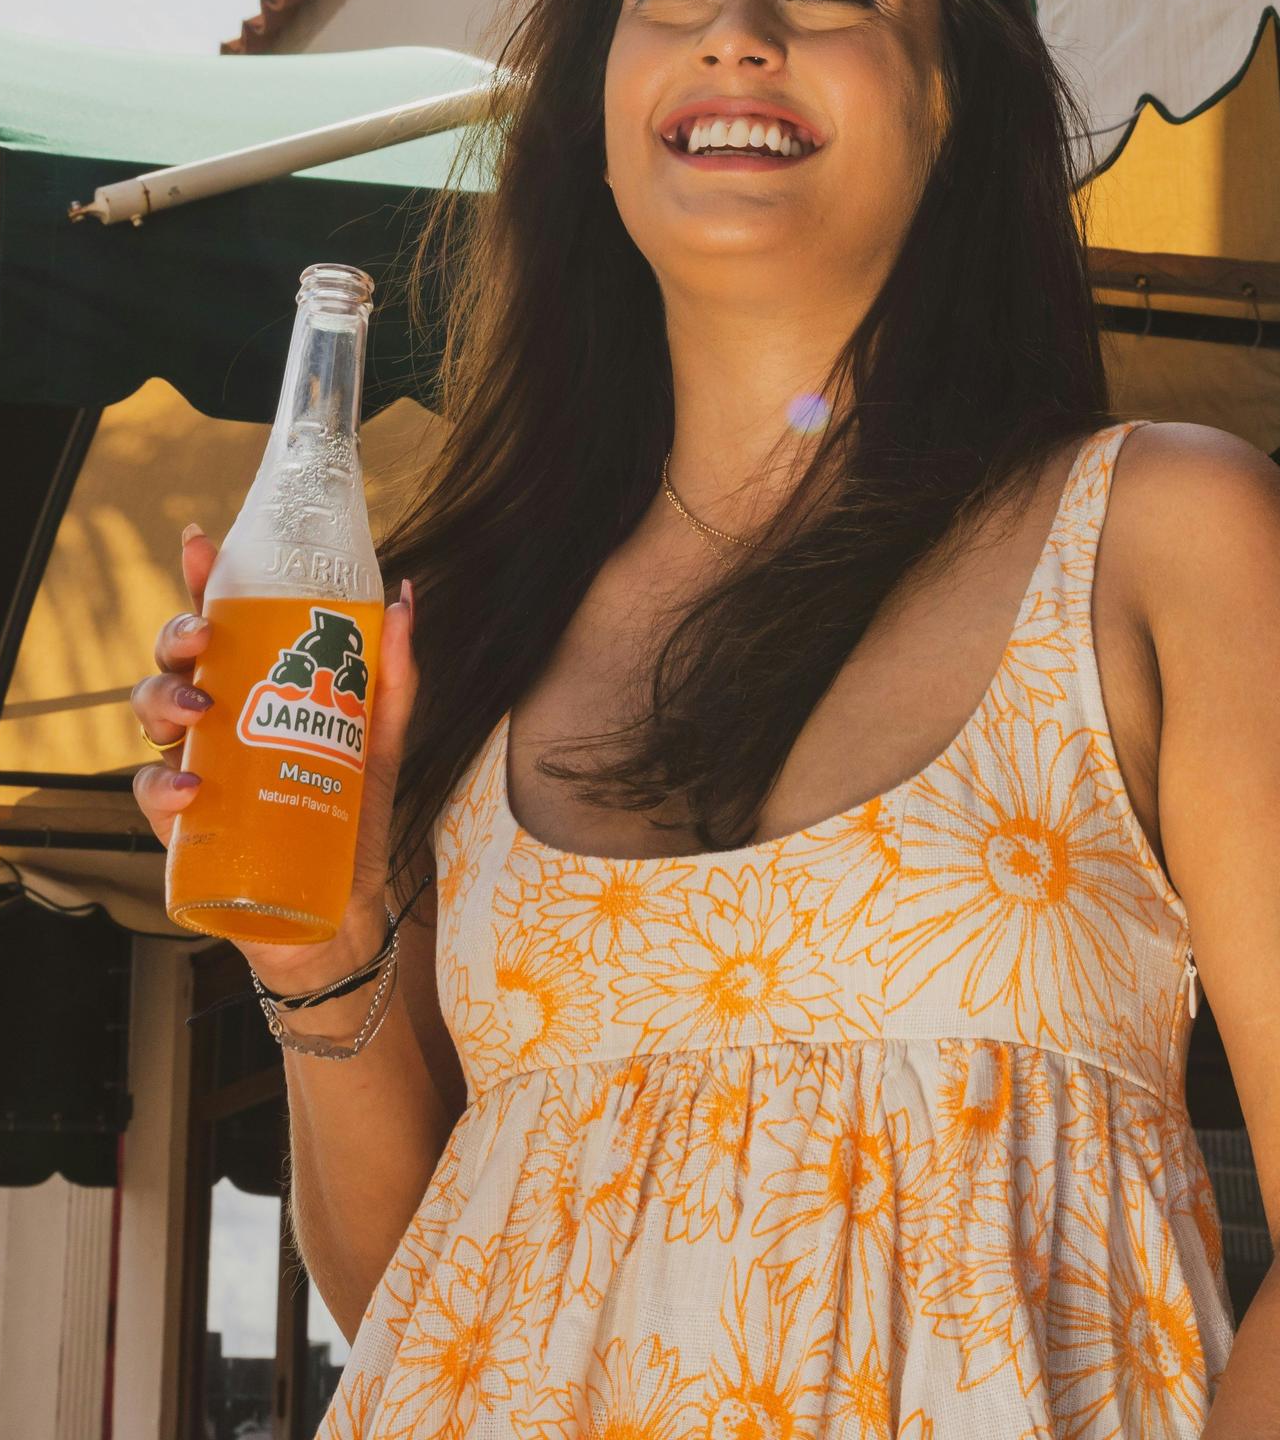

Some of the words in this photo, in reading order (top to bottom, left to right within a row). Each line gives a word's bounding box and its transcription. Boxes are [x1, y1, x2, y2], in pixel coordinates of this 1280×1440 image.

[267, 546, 381, 595] JARRIT
[256, 702, 363, 753] JARRITOS
[279, 761, 342, 794] Mango
[258, 788, 299, 806] Natural
[301, 796, 330, 814] Flavor
[331, 805, 349, 822] Soda
